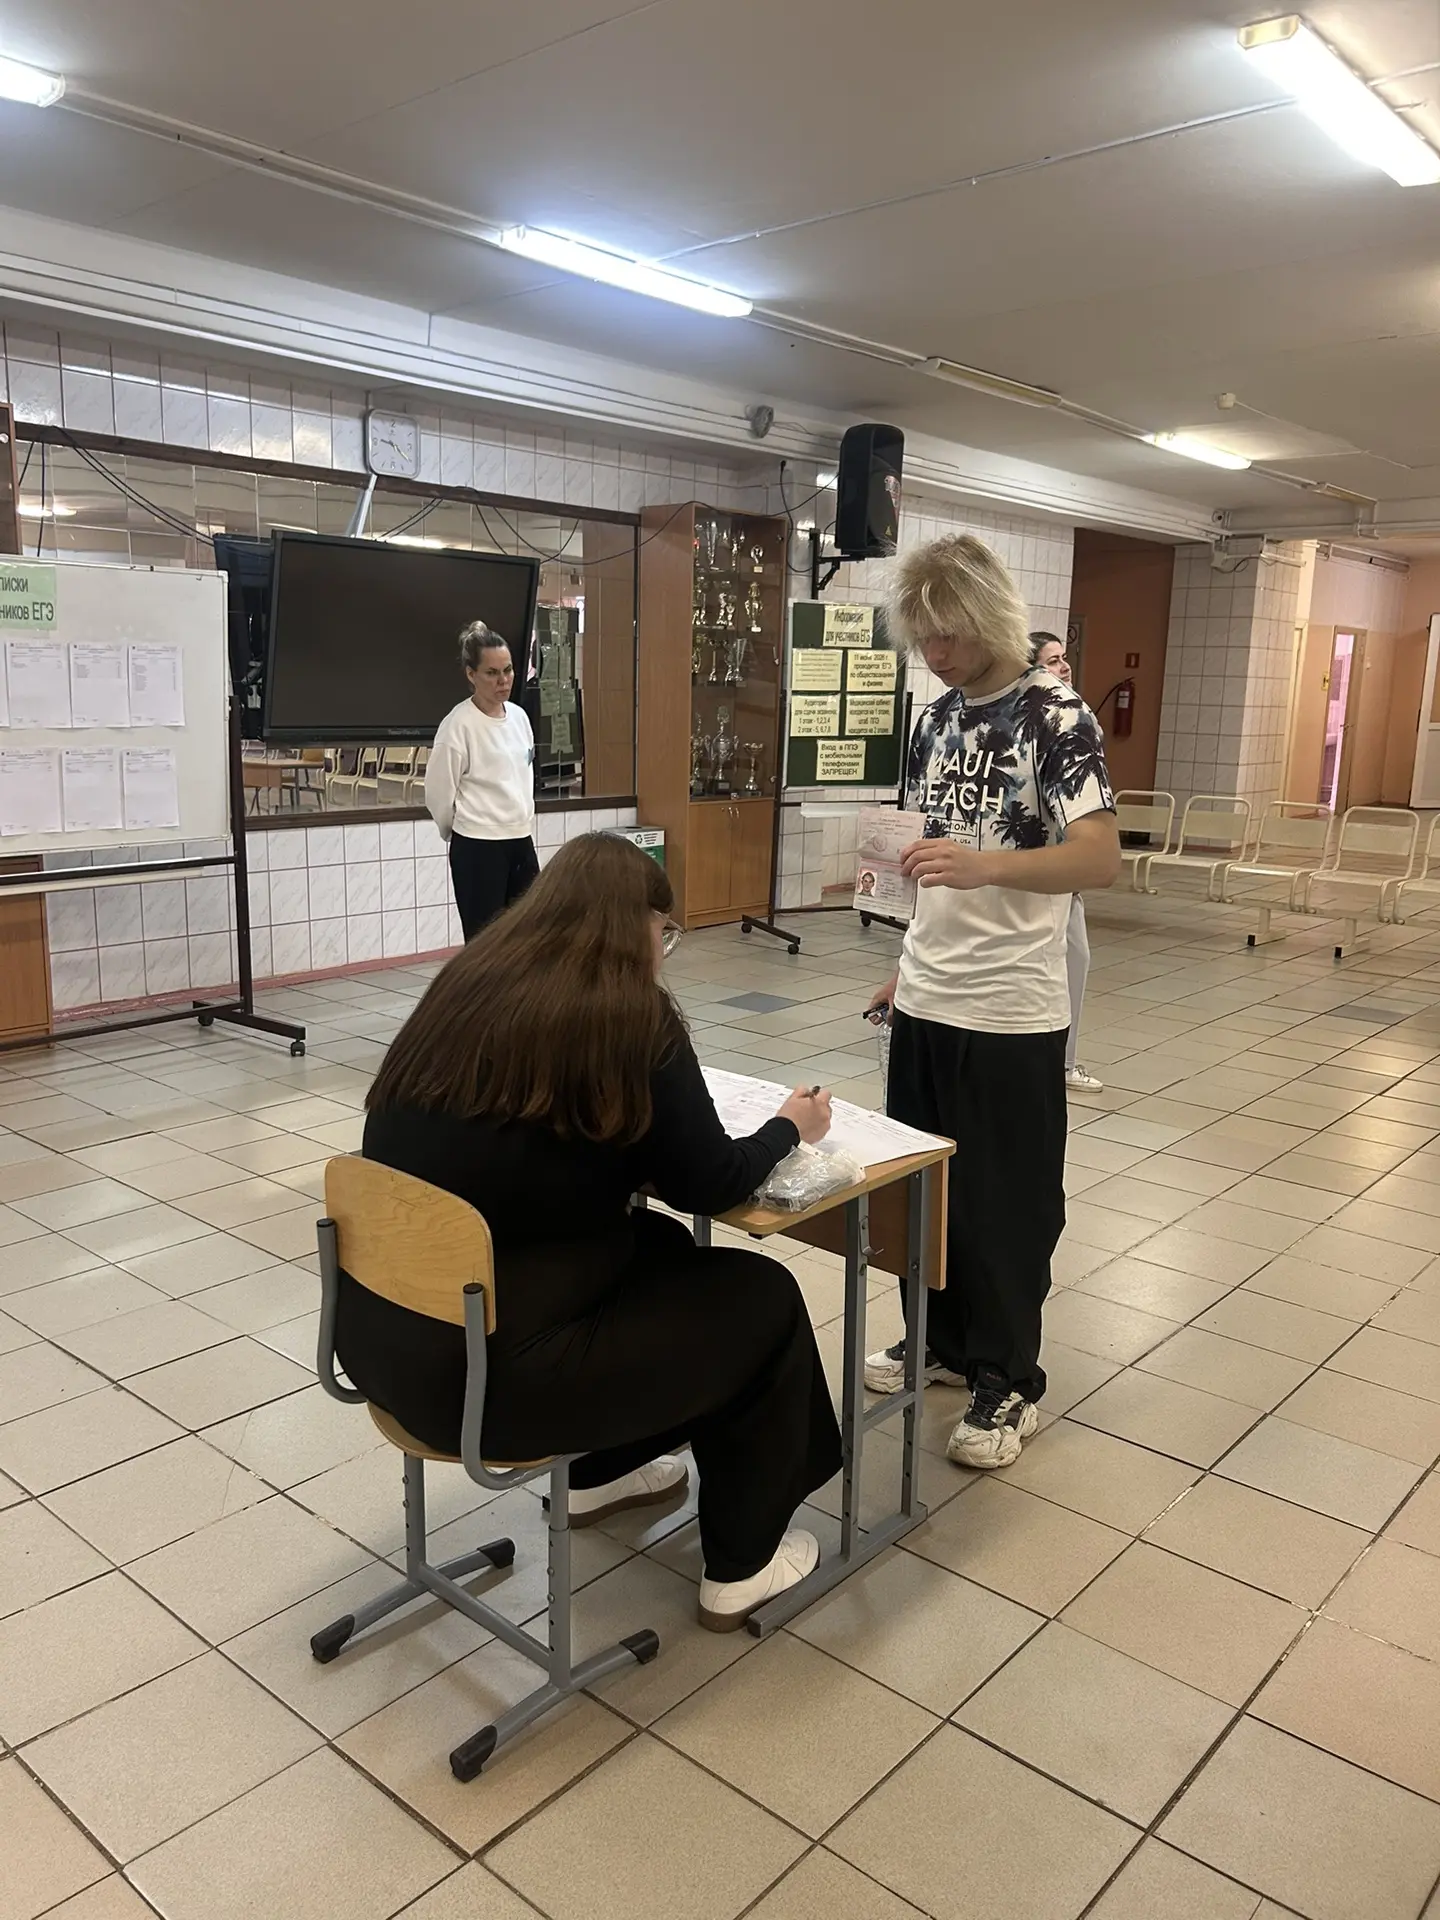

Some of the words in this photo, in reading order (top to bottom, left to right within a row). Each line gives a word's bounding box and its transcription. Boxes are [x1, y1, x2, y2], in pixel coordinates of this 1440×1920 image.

[32, 601, 55, 621] ЕГЭ
[861, 629, 871, 642] ЕГЭ
[881, 662, 892, 670] ЕГЭ
[821, 743, 837, 751] Вход
[844, 743, 859, 751] ППЭ
[822, 760, 860, 768] телефонами
[925, 748, 995, 779] MAUI
[918, 780, 1005, 815] BEACH
